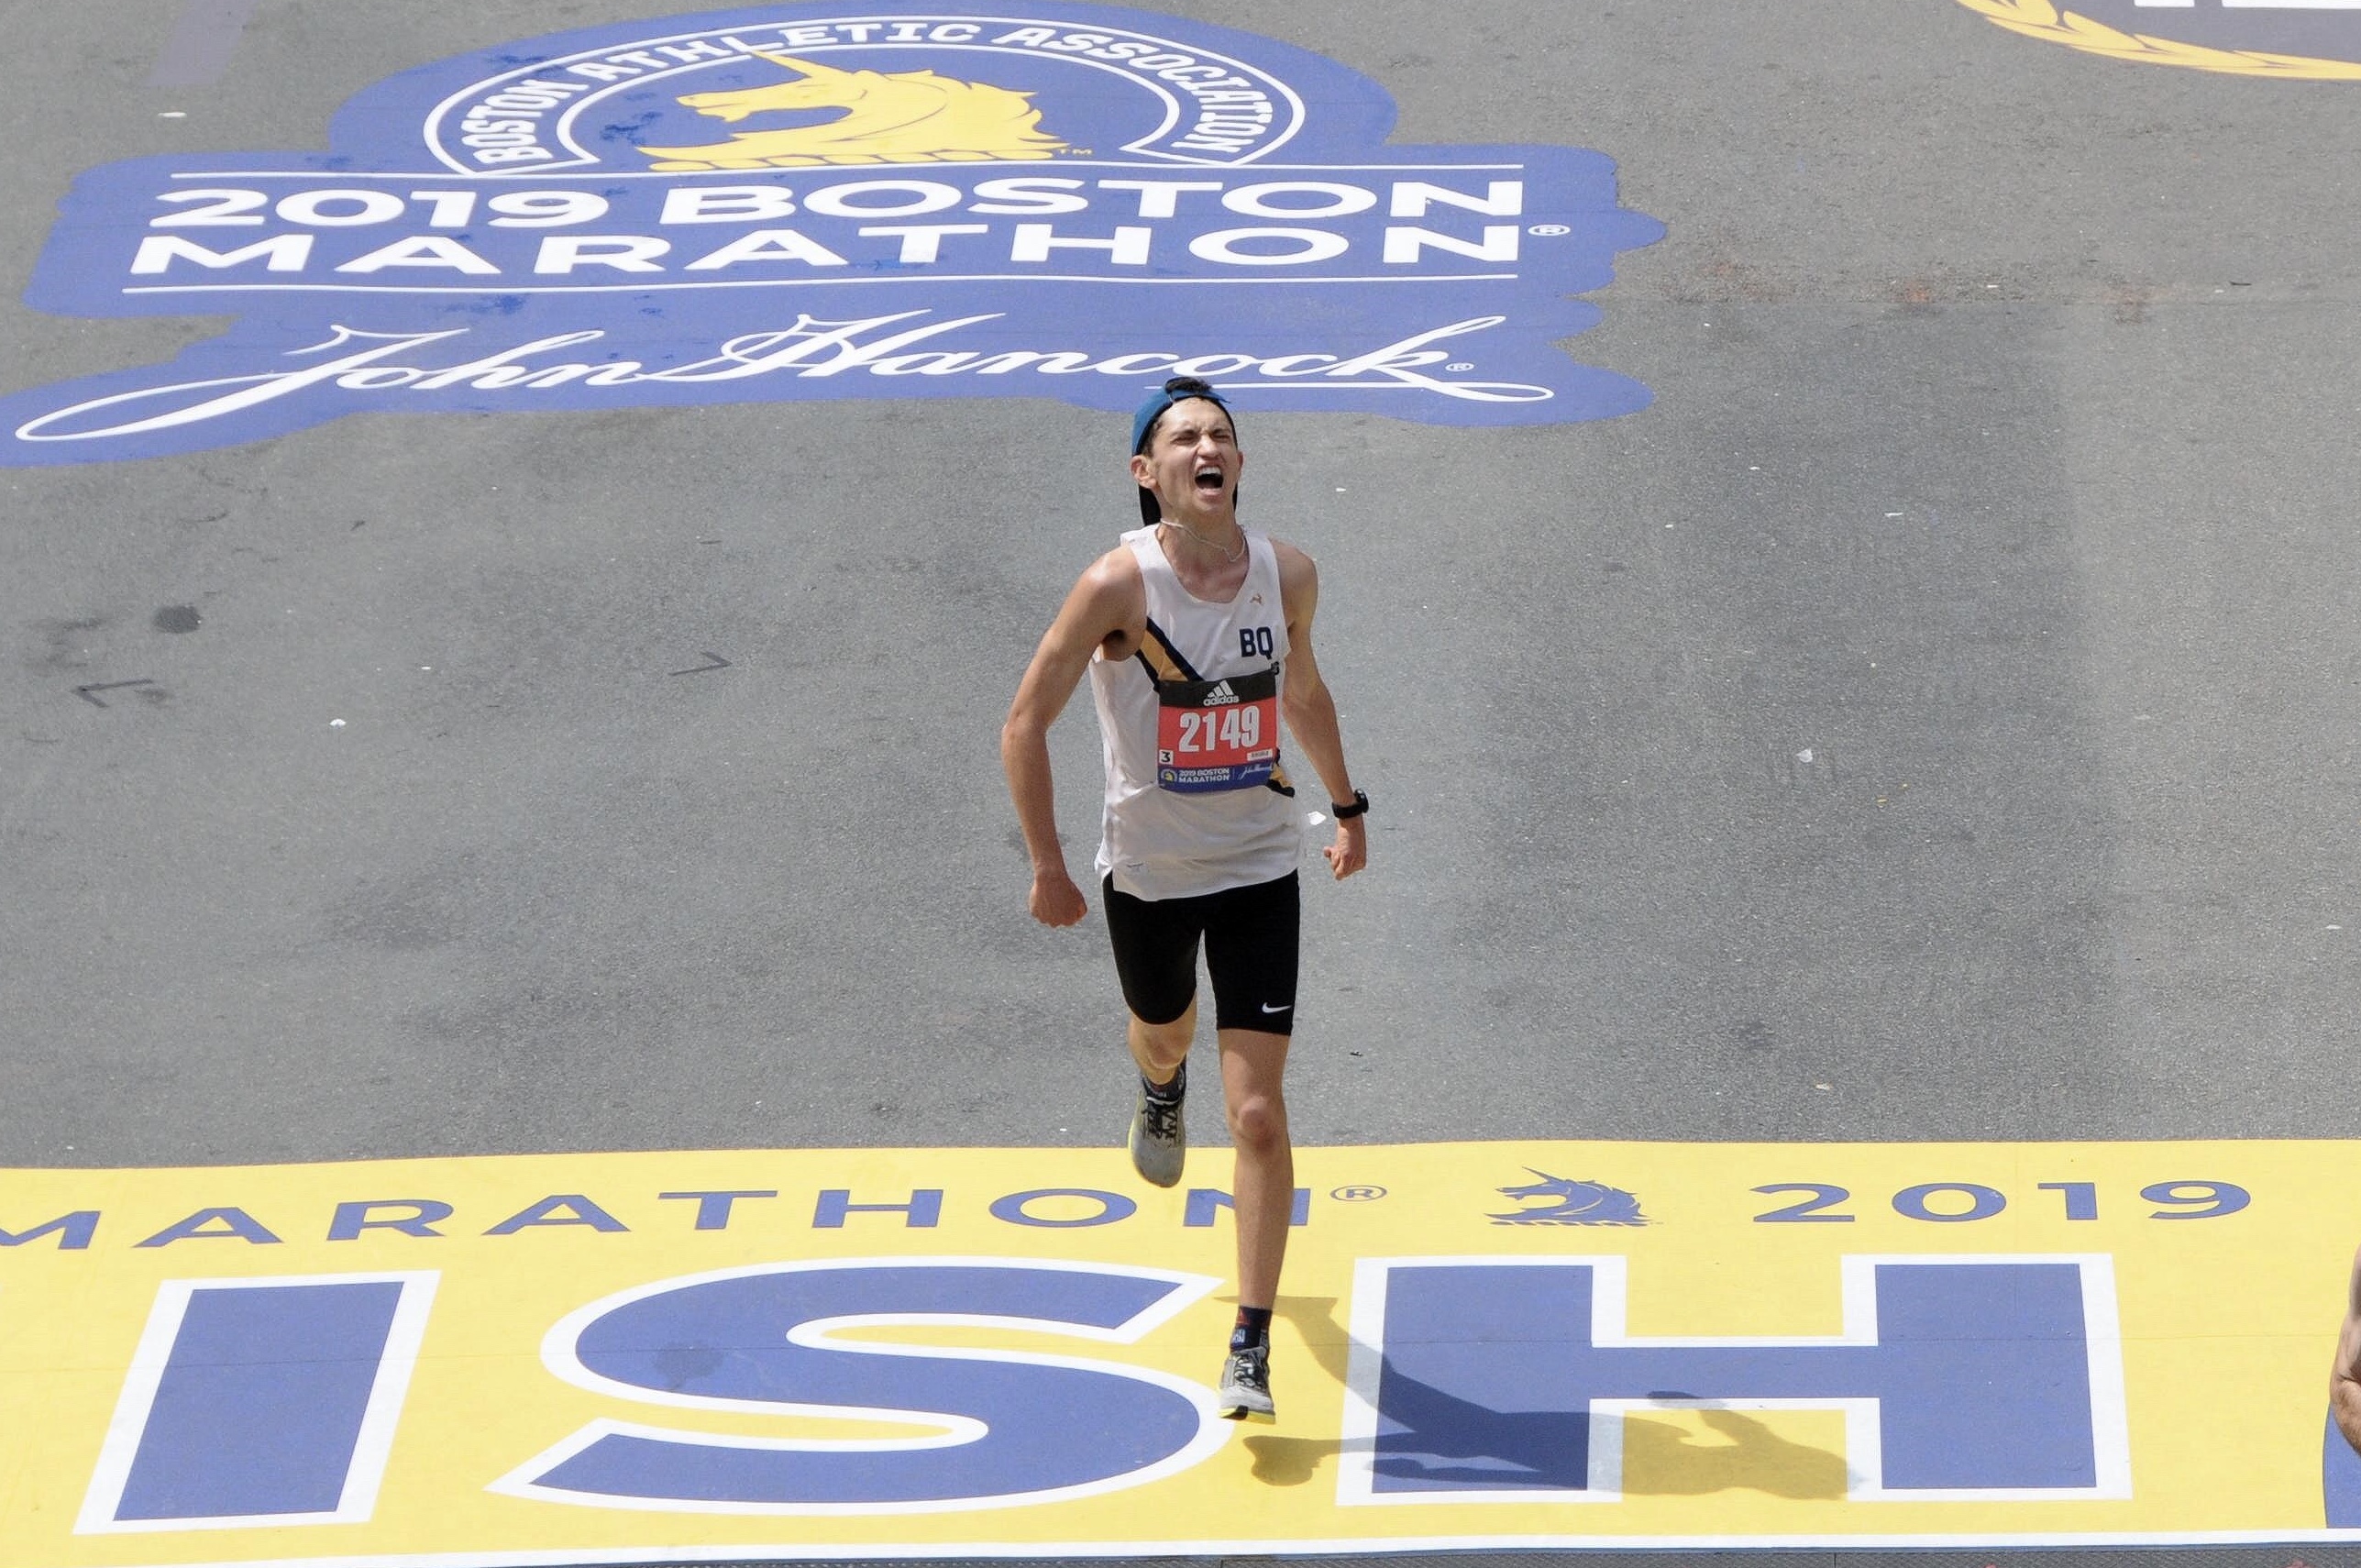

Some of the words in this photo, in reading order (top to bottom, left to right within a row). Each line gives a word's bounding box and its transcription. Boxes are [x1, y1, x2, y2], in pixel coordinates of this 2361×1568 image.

[460, 78, 590, 165] BOSTON
[567, 22, 982, 82] ATHLETIC
[990, 28, 1274, 154] ASSOCIATION
[149, 185, 609, 229] 2019
[660, 177, 1524, 226] BOSTON
[15, 324, 644, 441] John
[1239, 626, 1274, 660] BQ
[1203, 695, 1240, 706] adidas
[1178, 705, 1260, 753] 2149
[1161, 750, 1171, 763] 3
[1197, 767, 1230, 777] BOSTON
[1178, 774, 1230, 783] MARATHON
[1749, 1180, 2252, 1223] 2019
